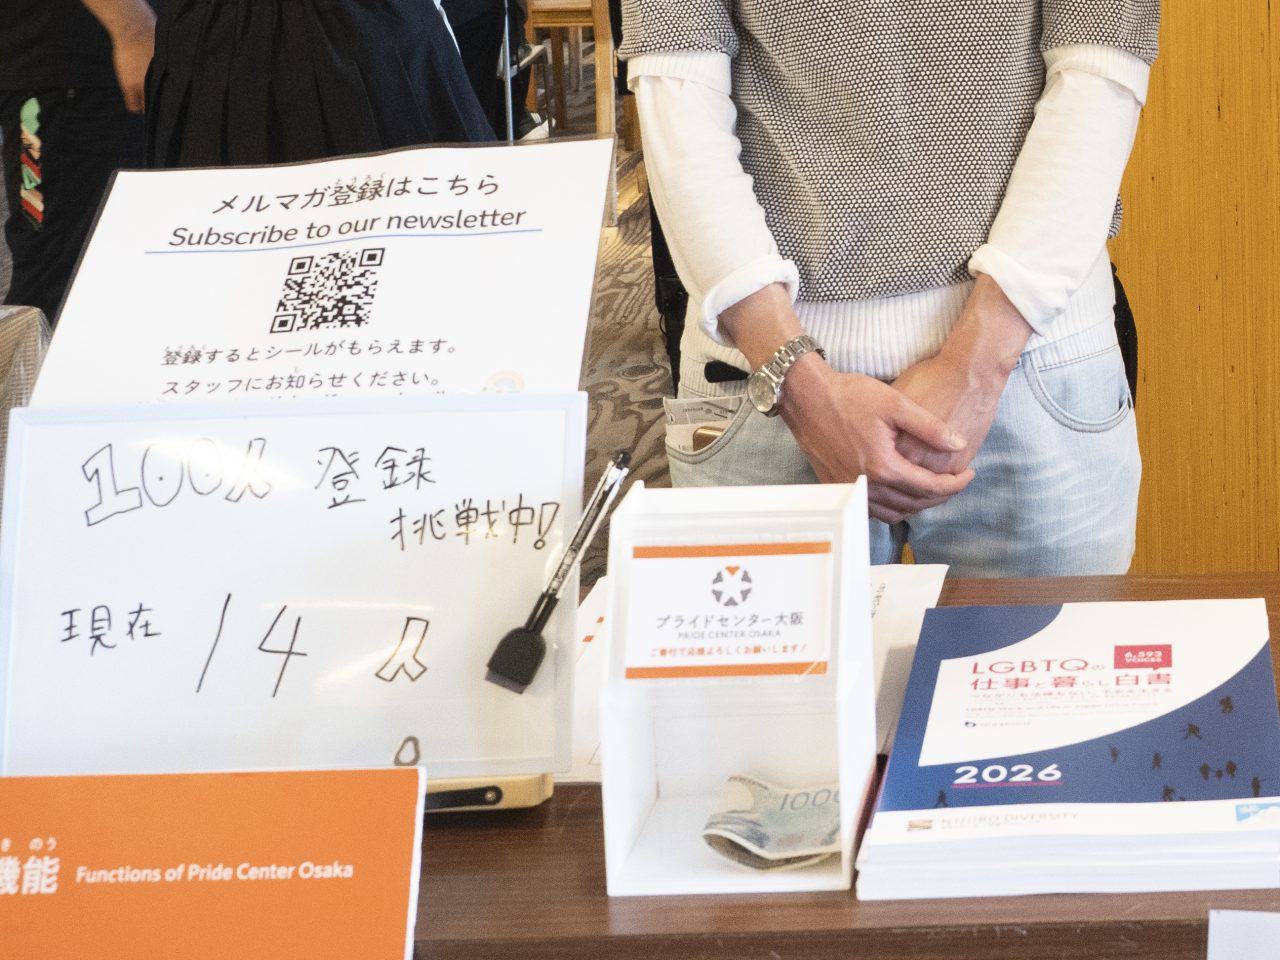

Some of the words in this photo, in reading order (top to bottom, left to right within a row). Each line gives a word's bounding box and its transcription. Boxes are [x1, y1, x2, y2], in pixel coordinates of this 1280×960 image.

[212, 172, 500, 215] メルマガ登録はこちら
[168, 216, 298, 247] Subscribe
[306, 219, 331, 240] to
[338, 216, 381, 235] our
[387, 207, 527, 230] newsletter
[160, 338, 457, 366] 登録するとシールがもらえます。
[162, 370, 441, 396] スタッフにお知らせください。
[314, 445, 437, 510] 登録
[656, 611, 804, 630] プライドセンター大阪
[60, 602, 163, 656] 現在
[196, 593, 308, 698] 14
[952, 762, 1063, 785] 2026
[75, 865, 161, 884] Functions
[164, 864, 184, 882] of
[187, 863, 233, 882] Pride
[236, 862, 295, 881] Center
[298, 860, 354, 880] Osaka
